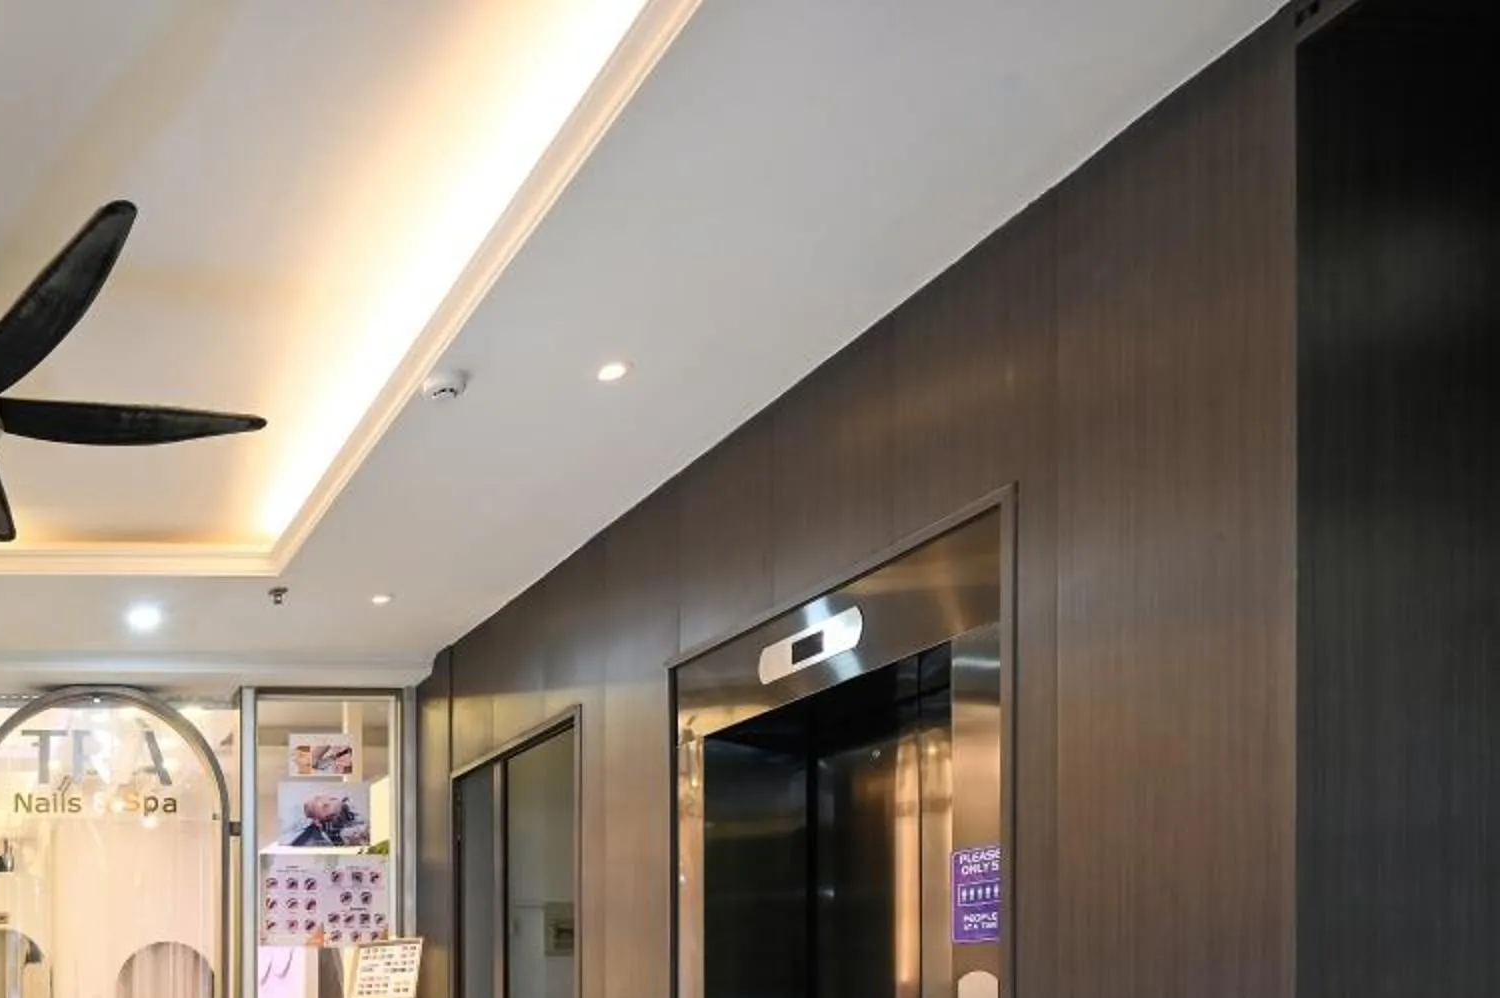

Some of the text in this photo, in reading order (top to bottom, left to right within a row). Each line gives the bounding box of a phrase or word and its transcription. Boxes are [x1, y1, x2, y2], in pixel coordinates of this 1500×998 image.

[14, 792, 82, 814] Nails
[124, 793, 177, 816] Spa
[961, 862, 989, 875] ONLY
